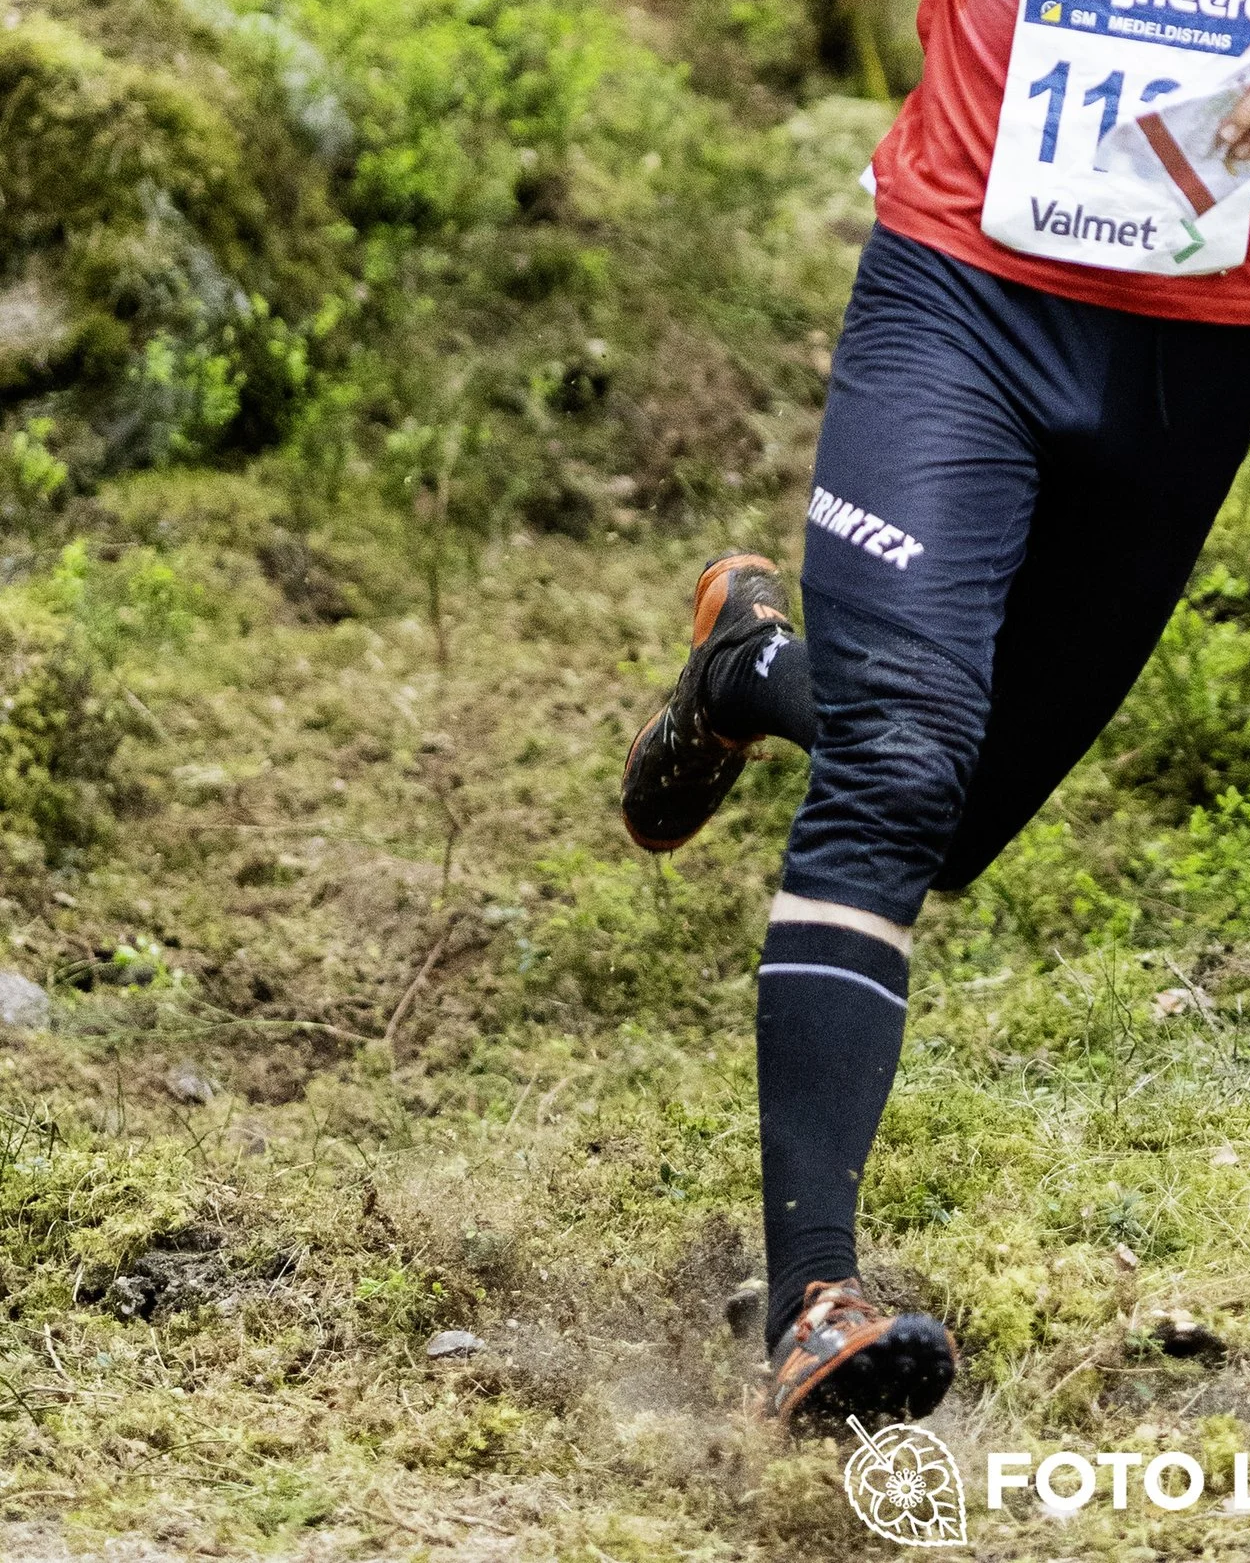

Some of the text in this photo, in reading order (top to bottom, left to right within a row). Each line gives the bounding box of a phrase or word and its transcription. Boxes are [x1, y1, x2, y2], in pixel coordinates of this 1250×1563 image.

[1070, 9, 1231, 50] SM MEDELDISTANS
[1030, 196, 1157, 250] Valmet
[808, 486, 925, 570] TRIMTEX
